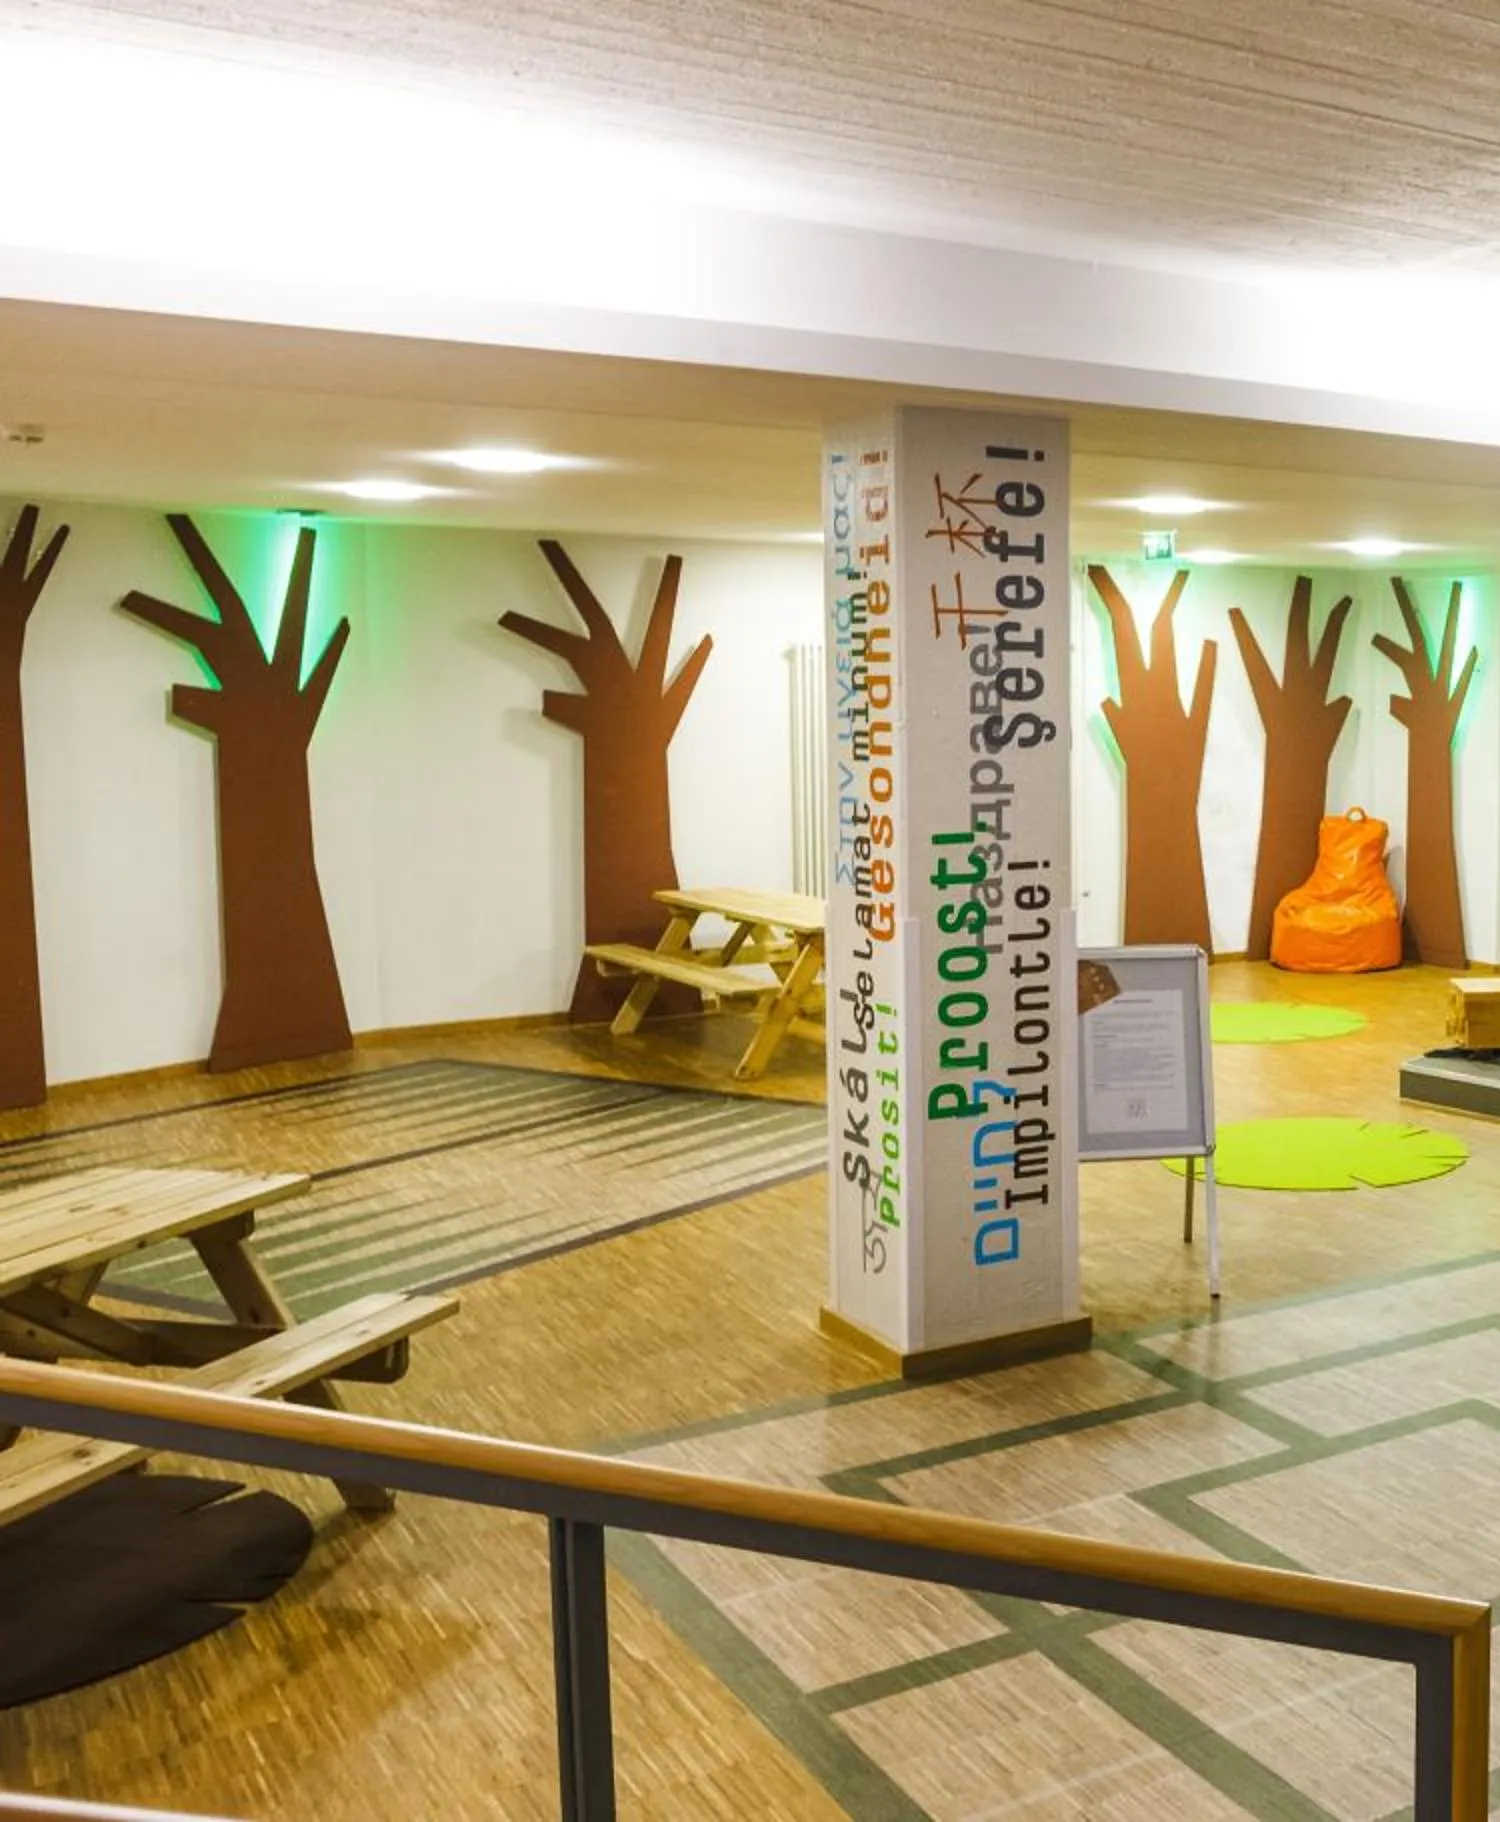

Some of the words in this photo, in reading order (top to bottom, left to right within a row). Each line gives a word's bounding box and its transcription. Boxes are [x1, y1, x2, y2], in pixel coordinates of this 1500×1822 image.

[847, 570, 871, 762] minum!
[925, 472, 1009, 650] 干杯
[983, 446, 1056, 749] Şerefe!
[860, 450, 896, 942] Gesondheid!
[852, 801, 876, 1030] Selamat
[928, 820, 990, 1120] Proost!
[839, 986, 872, 1190] Skál!
[875, 1003, 900, 1228] Prosit!
[1003, 858, 1056, 1210] Impilontle!
[971, 1080, 1020, 1266] לחיים
